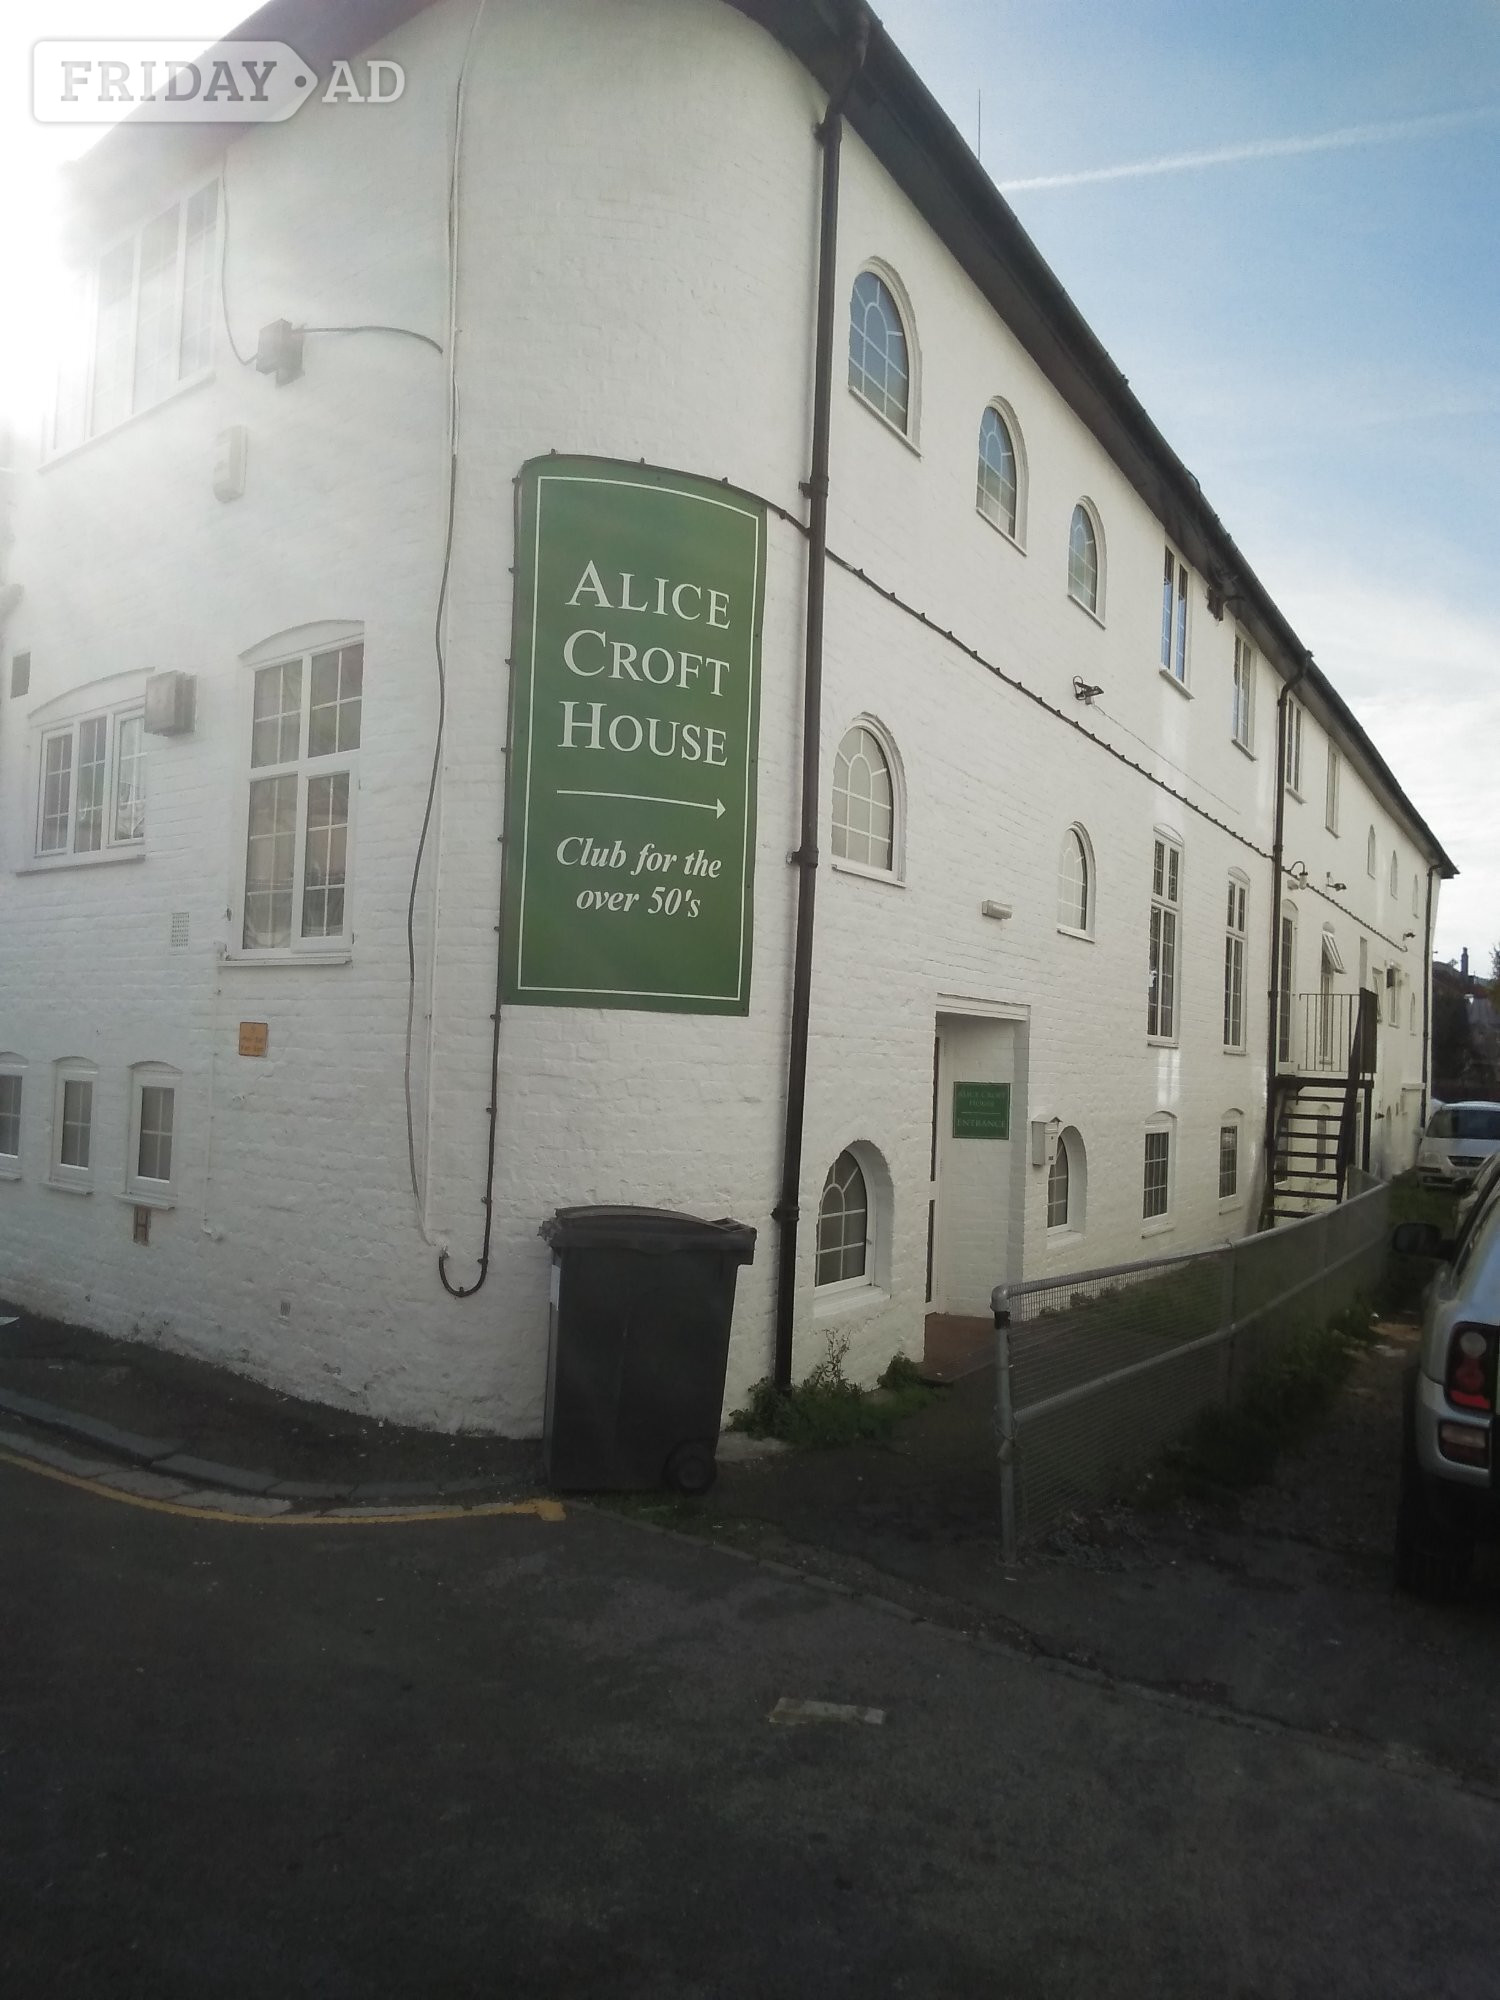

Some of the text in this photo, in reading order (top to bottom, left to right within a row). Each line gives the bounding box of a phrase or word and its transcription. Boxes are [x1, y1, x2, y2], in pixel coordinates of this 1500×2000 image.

[564, 559, 731, 629] ALICE
[562, 629, 731, 697] CROFT
[556, 701, 728, 767] HOUSE
[556, 836, 722, 879] Club for the
[576, 886, 701, 918] over 50's
[957, 1119, 1007, 1128] ENTRANCE
